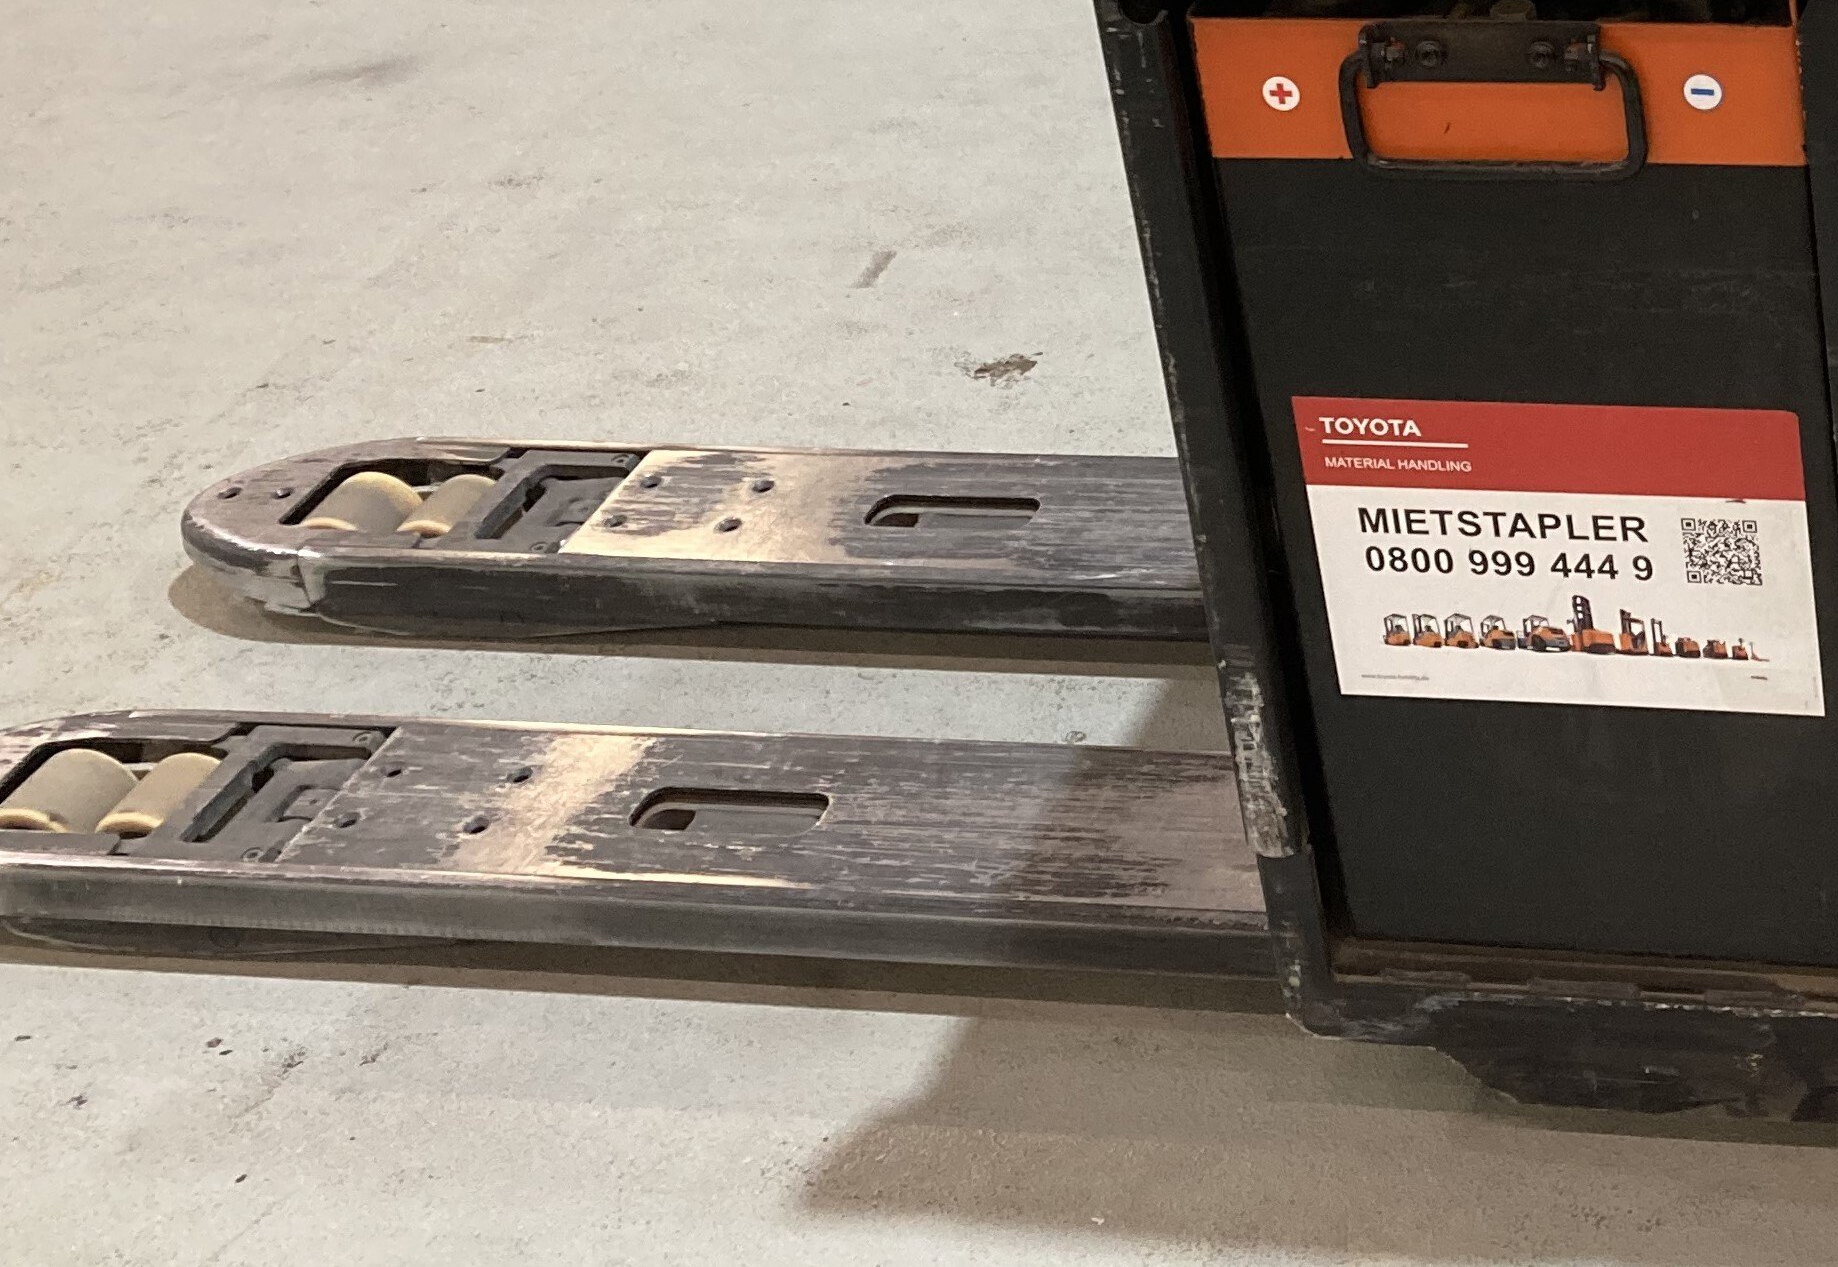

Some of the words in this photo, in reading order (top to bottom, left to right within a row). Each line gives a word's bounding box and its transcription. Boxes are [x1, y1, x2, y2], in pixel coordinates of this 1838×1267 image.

[1318, 416, 1422, 437] TOYOTA
[1324, 456, 1395, 470] MATERIAL
[1397, 459, 1473, 473] HANDLING
[1357, 507, 1649, 543] MIETSTAPLER
[1365, 546, 1454, 574] 0800
[1468, 549, 1536, 577] 999
[1550, 552, 1619, 580] 444
[1632, 555, 1654, 581] 9
